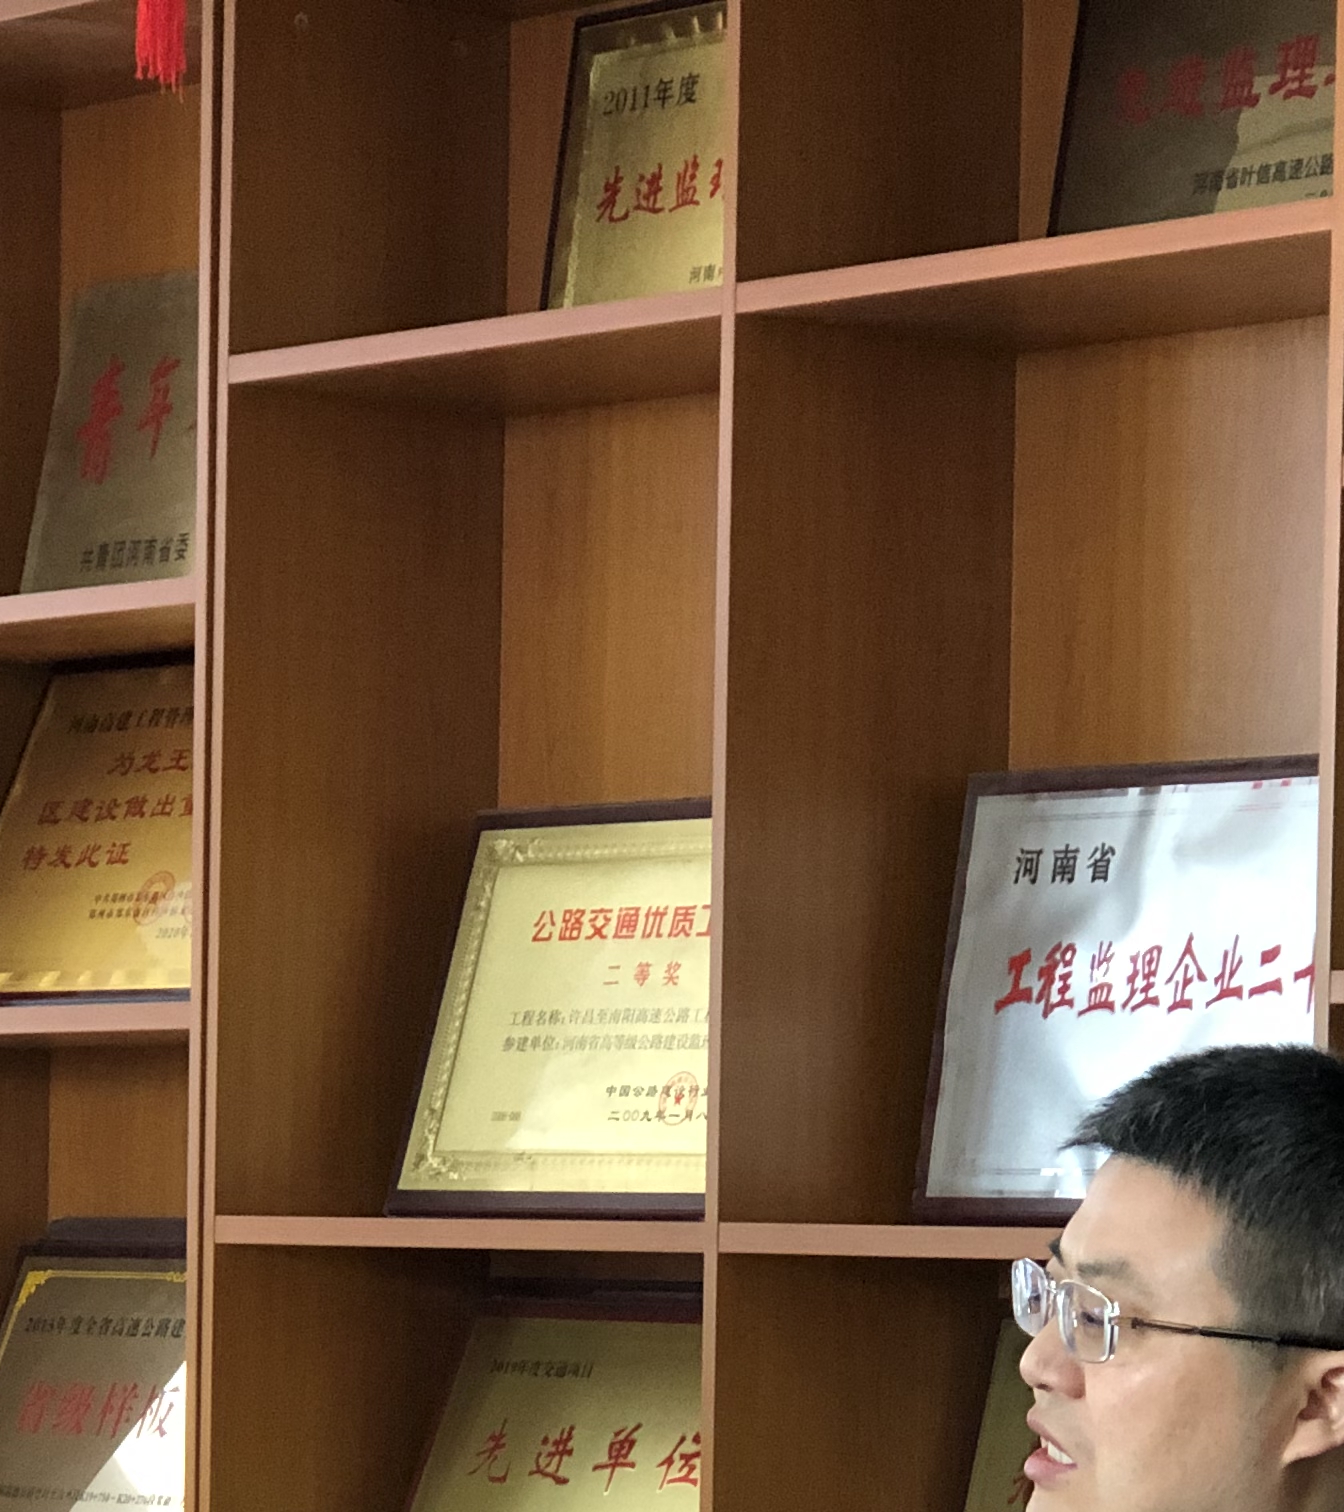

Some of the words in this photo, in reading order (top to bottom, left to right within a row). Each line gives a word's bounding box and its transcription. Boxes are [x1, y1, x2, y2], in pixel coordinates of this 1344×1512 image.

[602, 72, 700, 116] 2011年度
[689, 262, 723, 285] 河南
[76, 355, 195, 485] 青年
[1012, 842, 1116, 886] 河南省
[602, 960, 682, 988] 二等奖
[467, 1417, 702, 1494] 先进单位
